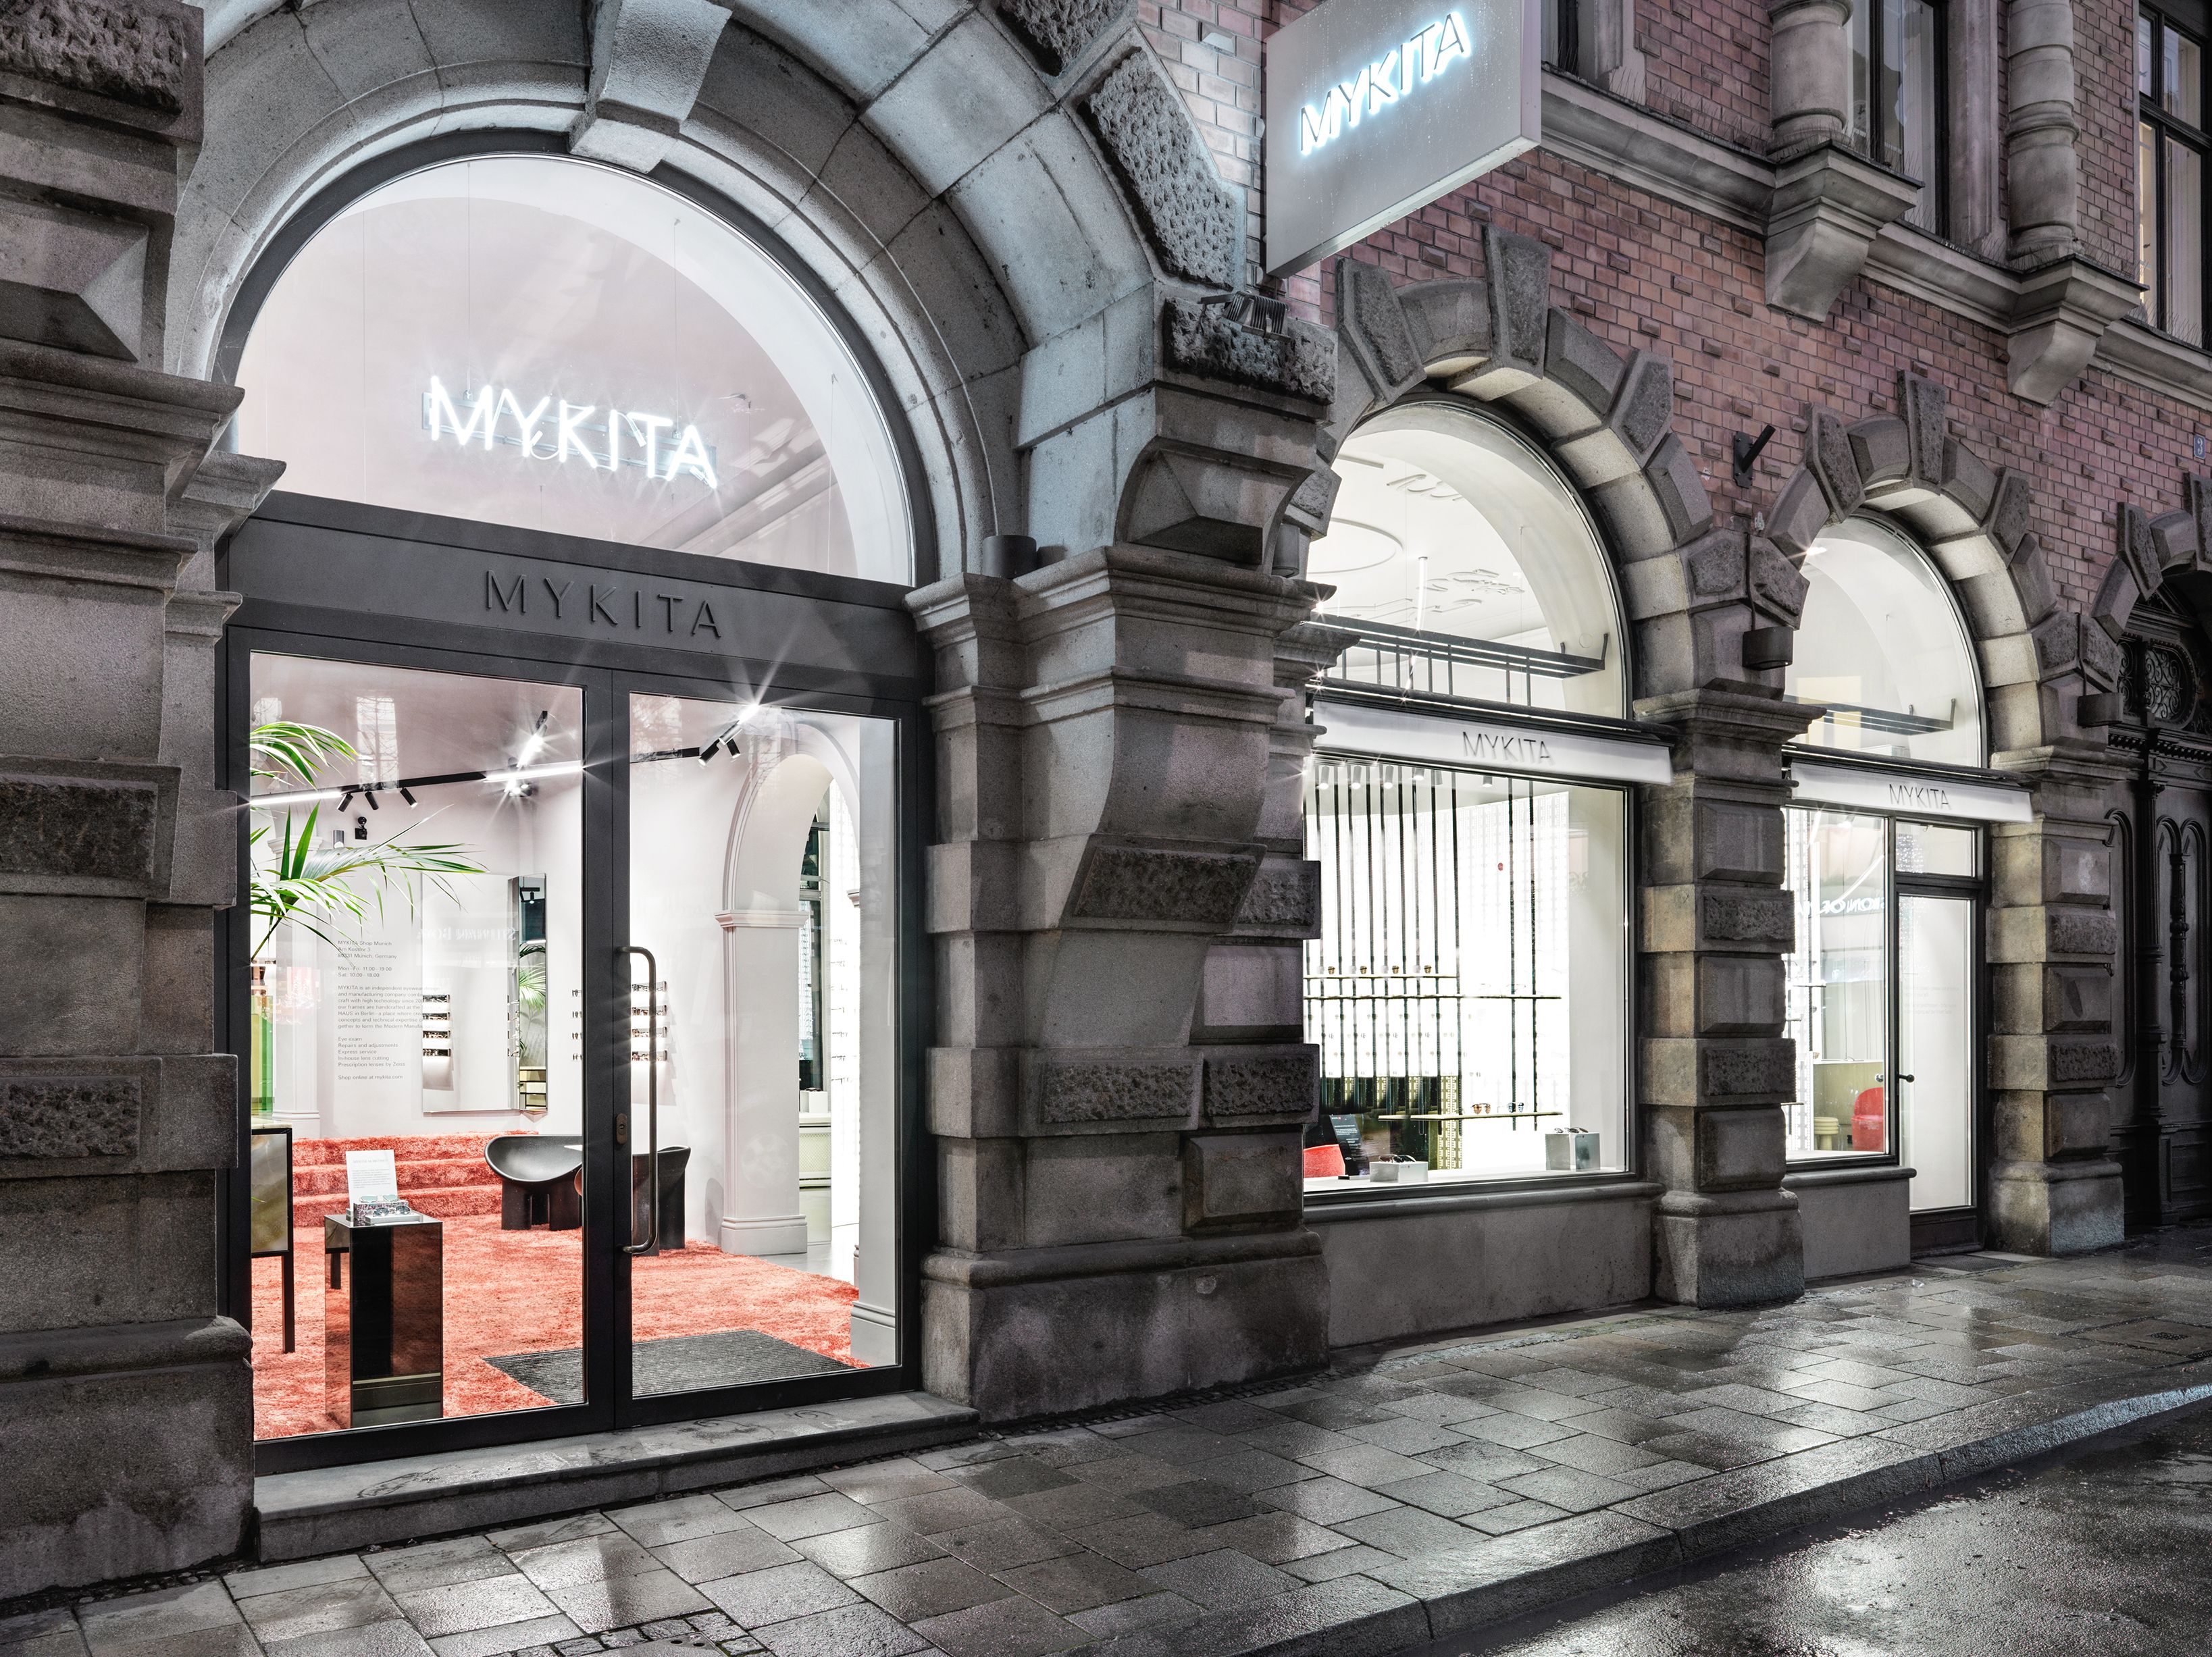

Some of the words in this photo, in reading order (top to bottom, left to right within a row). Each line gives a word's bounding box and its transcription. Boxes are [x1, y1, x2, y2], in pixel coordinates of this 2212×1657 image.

[1300, 12, 1470, 155] MYKITA
[430, 375, 718, 490] MYKITA
[2197, 438, 2203, 454] 3
[486, 569, 721, 638] MYKITA
[1462, 731, 1555, 766] MYKITA
[1888, 783, 1952, 811] MYKITA
